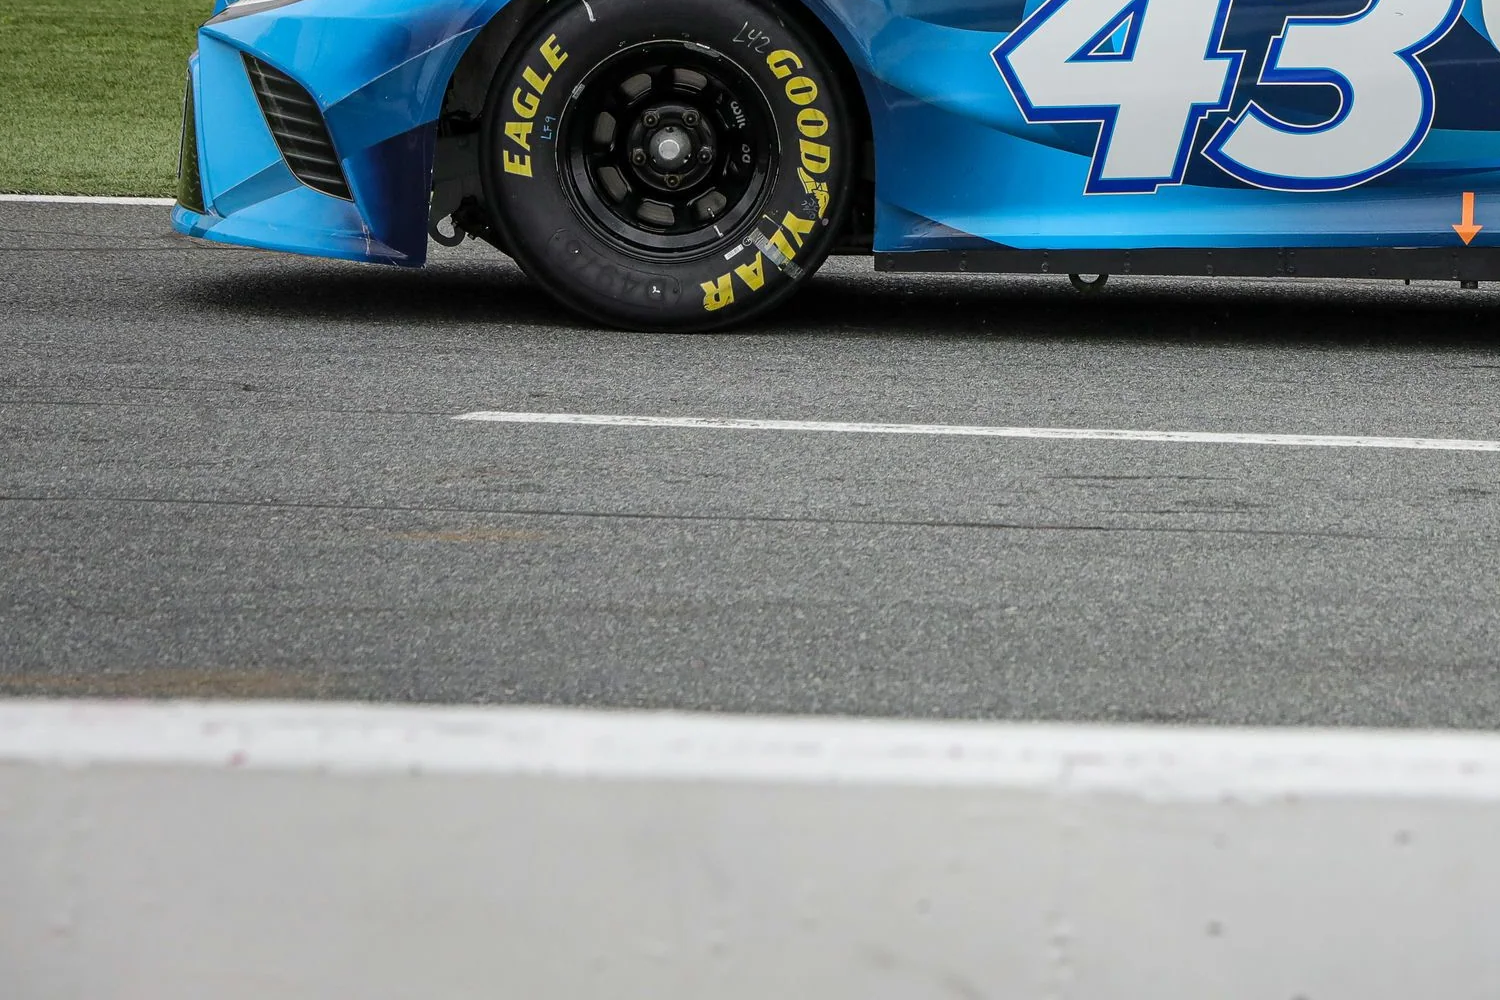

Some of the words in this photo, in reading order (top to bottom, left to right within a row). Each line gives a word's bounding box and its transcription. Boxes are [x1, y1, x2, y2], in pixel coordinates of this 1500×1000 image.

[732, 20, 771, 54] L42
[503, 33, 569, 178] EAGLE
[540, 115, 556, 140] LF9
